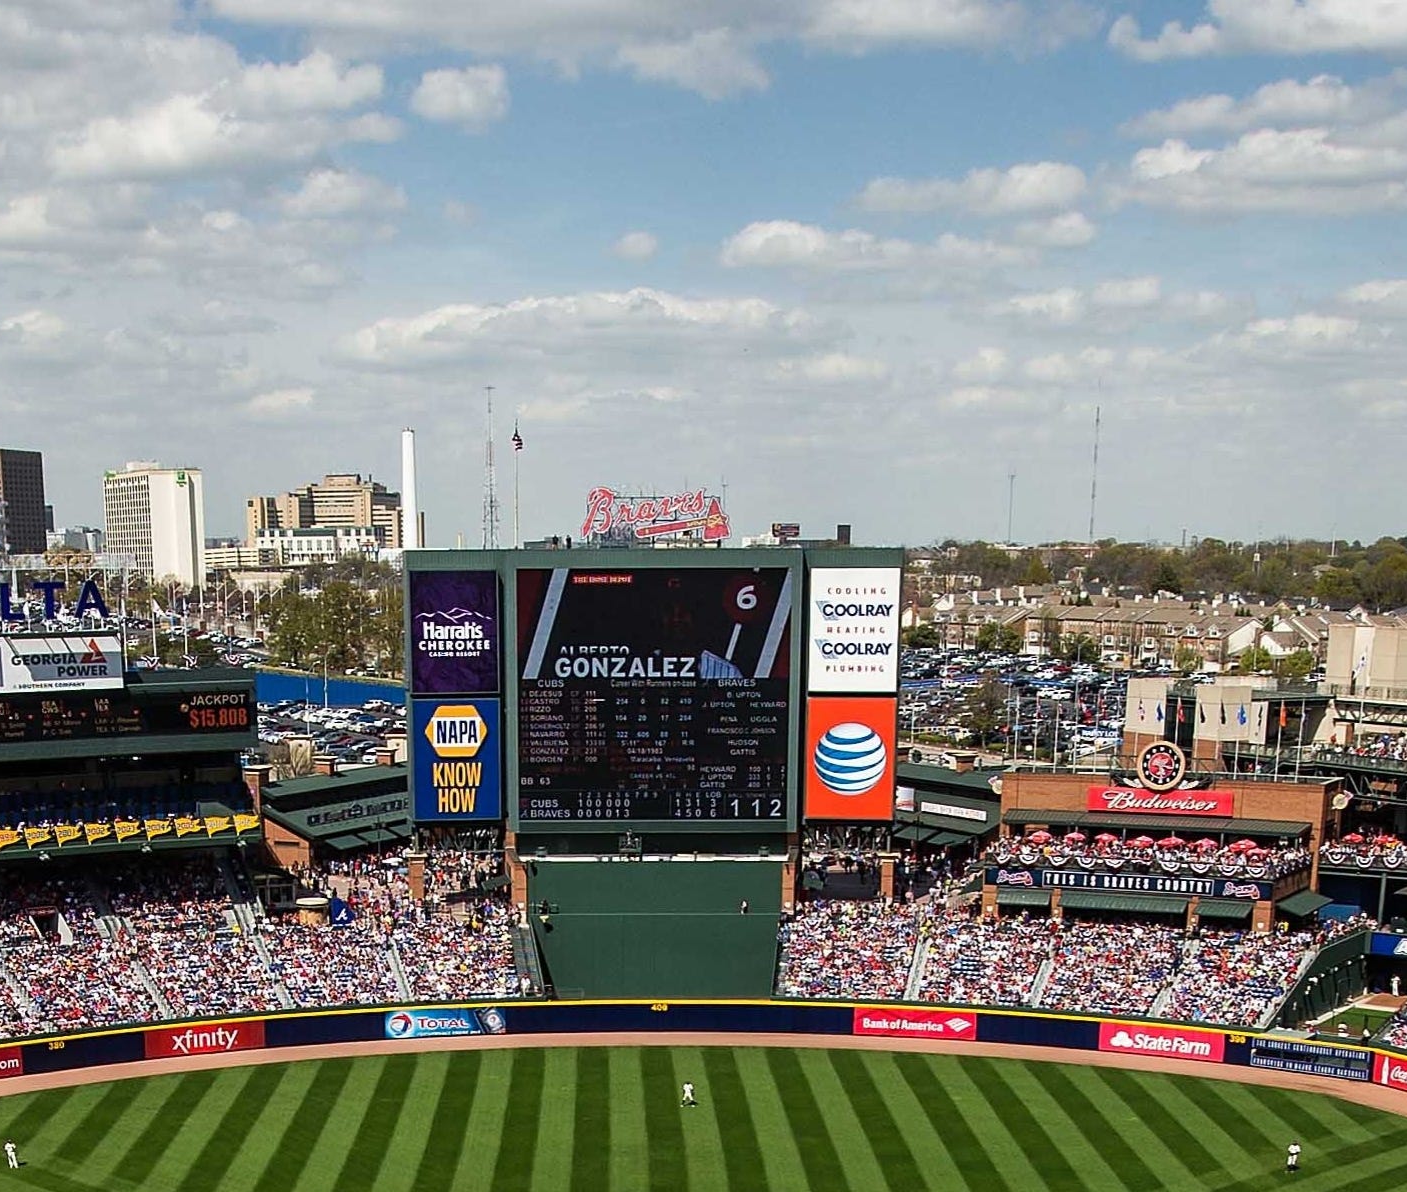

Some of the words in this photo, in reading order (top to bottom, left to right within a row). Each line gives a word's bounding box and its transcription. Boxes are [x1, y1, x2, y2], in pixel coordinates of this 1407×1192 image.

[581, 487, 706, 540] Braves
[736, 585, 758, 609] 6
[823, 604, 893, 616] COOLRAY
[423, 622, 483, 639] Harrah's
[419, 640, 490, 650] CHEROKEE
[822, 642, 892, 655] COOLRAY
[11, 654, 77, 666] GEORGIA
[57, 664, 108, 676] POWER
[555, 657, 696, 677] GONZALEZ
[538, 680, 564, 688] CUBS
[718, 679, 756, 687] BRAVES
[190, 695, 246, 705] JACKPOT
[436, 720, 478, 744] NAPA
[433, 762, 482, 787] KNOW
[438, 788, 475, 813] HOW
[531, 800, 559, 808] CUBS
[578, 800, 583, 808] 1
[586, 800, 592, 808] 0
[595, 800, 601, 808] 0
[606, 800, 612, 808] 0
[615, 800, 621, 808] 0
[624, 800, 630, 808] 0
[686, 799, 691, 807] 3
[710, 799, 716, 807] 3
[1102, 790, 1217, 810] Budweiser
[531, 810, 570, 818] BRAVES
[578, 810, 583, 818] 0
[586, 810, 592, 818] 0
[595, 810, 601, 818] 0
[606, 810, 612, 818] 0
[615, 810, 621, 818] 1
[624, 810, 630, 818] 3
[731, 799, 739, 816] 1
[752, 799, 759, 816] 1
[770, 799, 781, 816] 2
[1046, 873, 1074, 886] THIS
[1084, 876, 1096, 887] IS
[1104, 876, 1149, 890] BRAVES
[1157, 879, 1212, 894] COUNTRY
[417, 1017, 470, 1029] TOTAL
[863, 1018, 889, 1029] Bank
[889, 1019, 901, 1030] of
[900, 1020, 944, 1032] America
[48, 1041, 65, 1050] 380
[172, 1027, 238, 1054] xfinity
